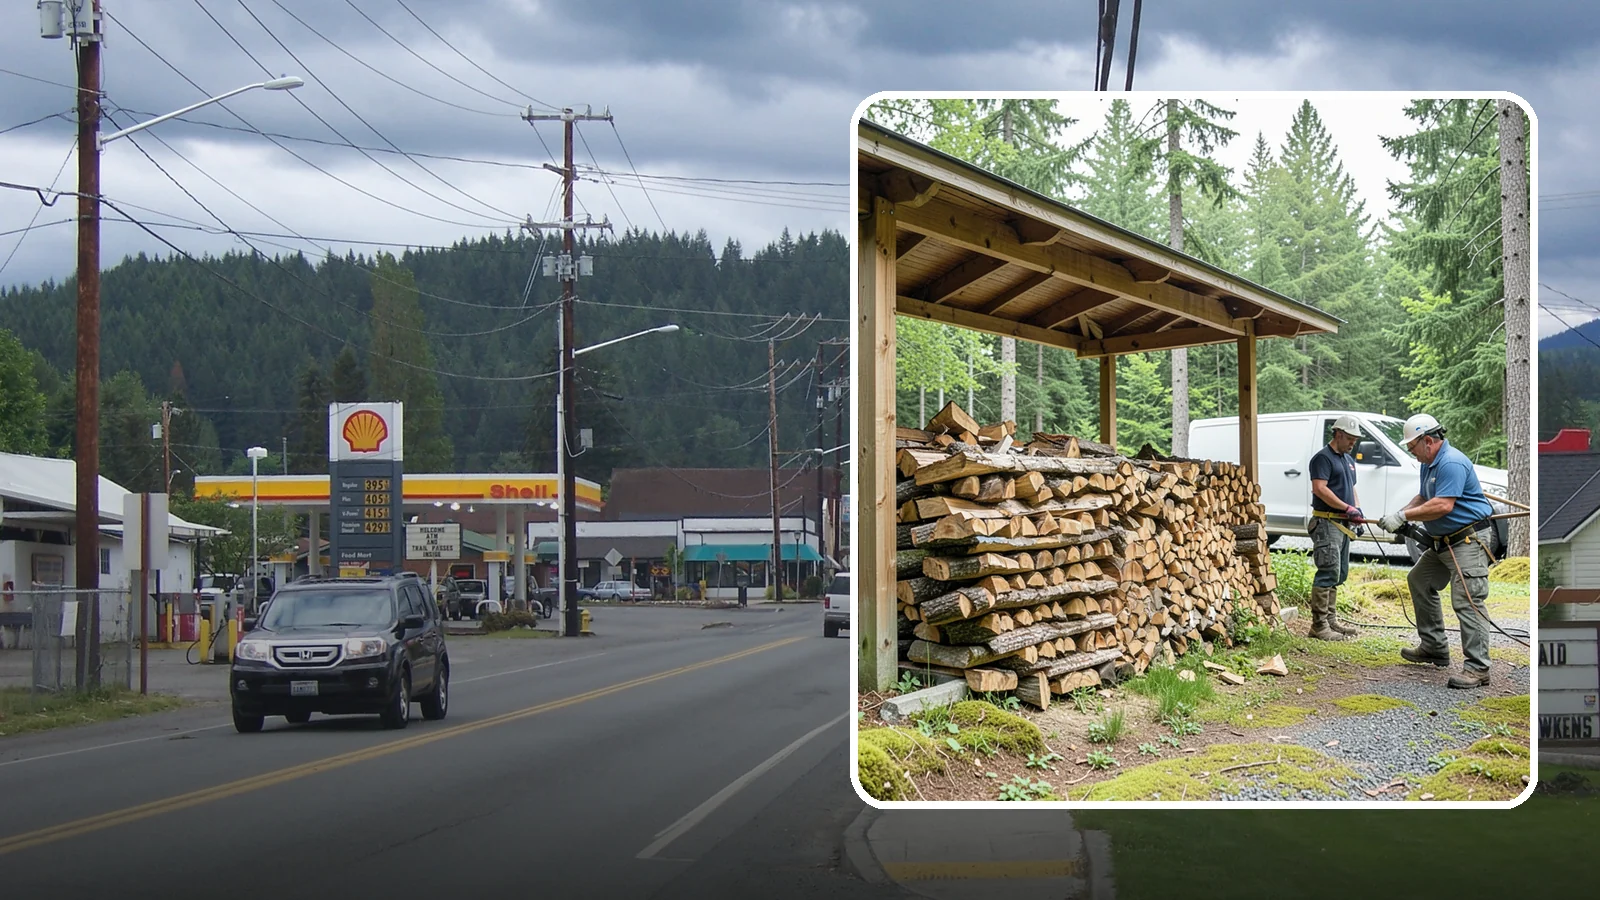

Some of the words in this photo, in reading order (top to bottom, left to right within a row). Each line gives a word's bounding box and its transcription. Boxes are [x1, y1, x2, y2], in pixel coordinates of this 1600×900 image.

[366, 480, 383, 490] 395
[490, 484, 547, 499] Shell
[366, 494, 383, 504] 405
[366, 508, 383, 518] 415
[366, 522, 383, 532] 429
